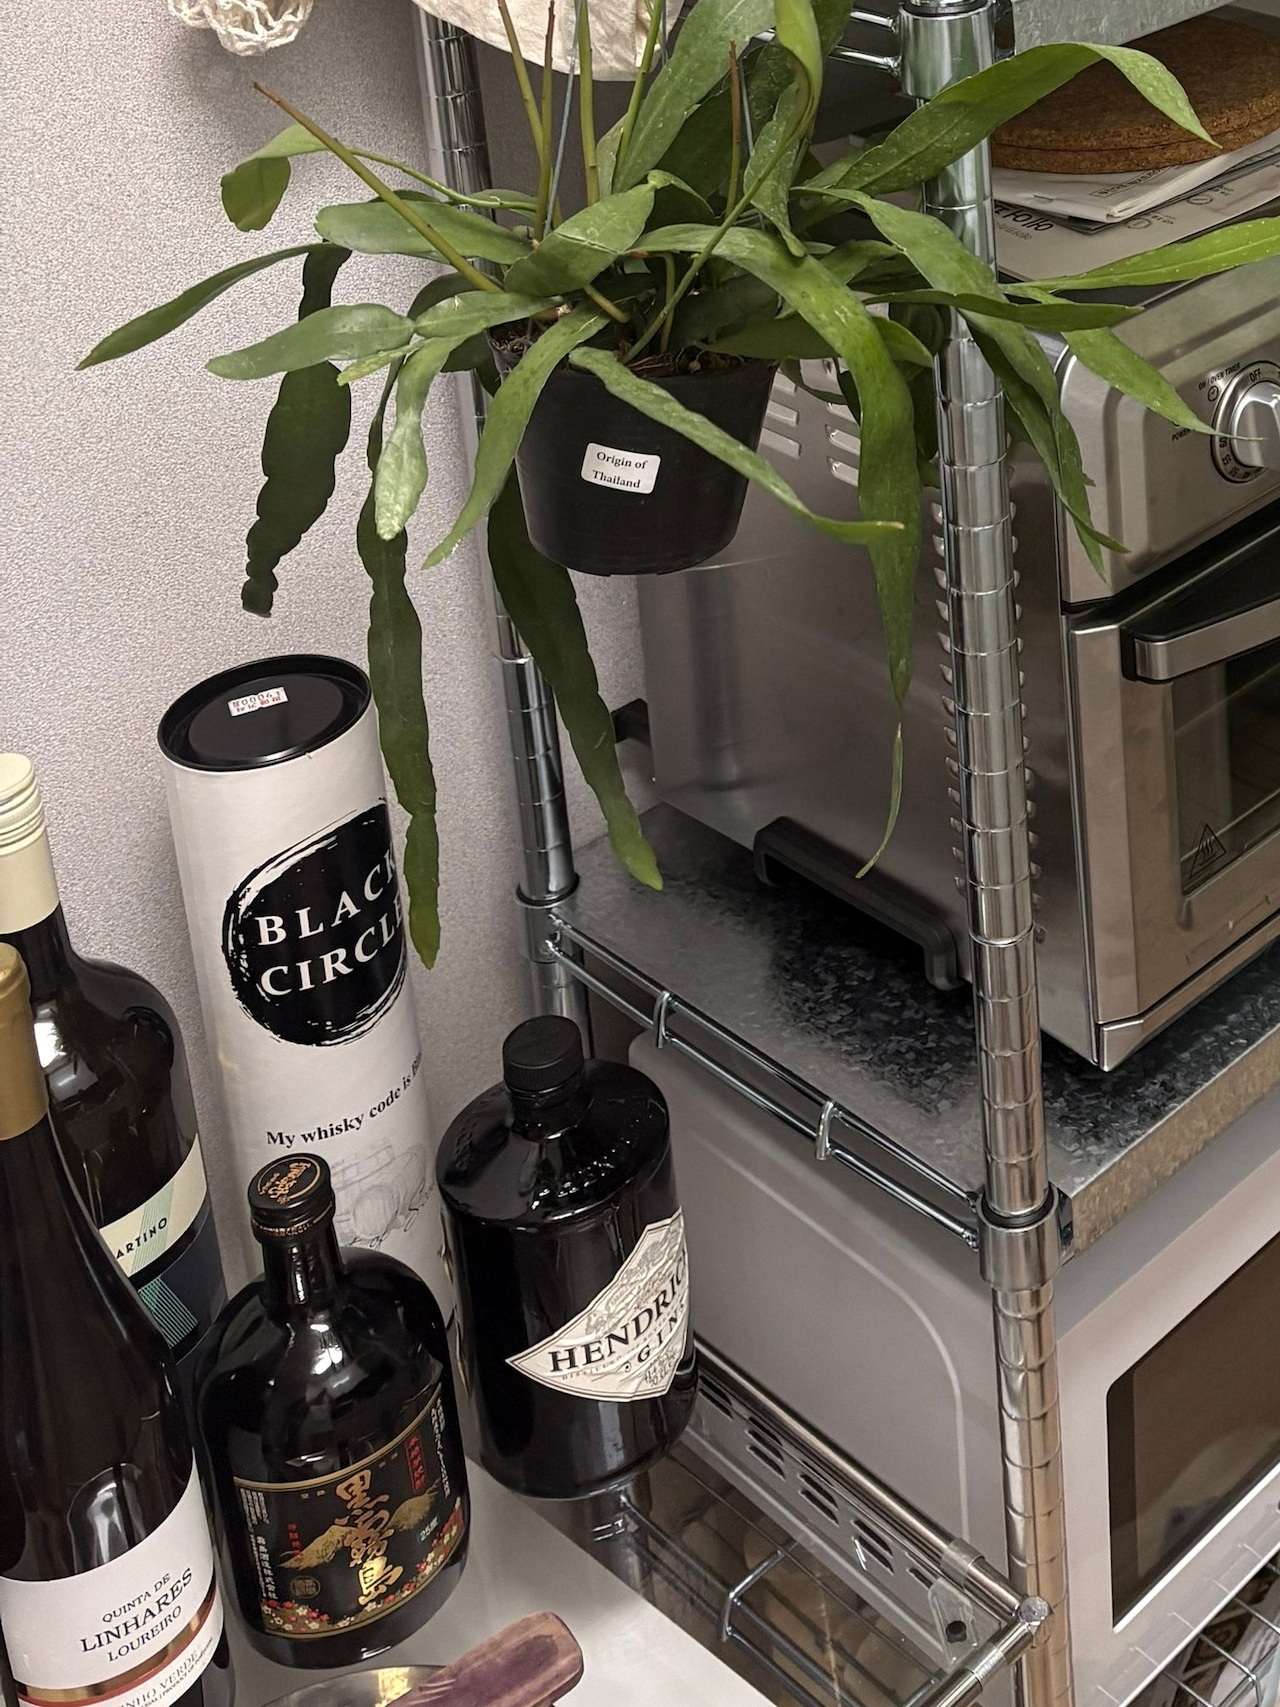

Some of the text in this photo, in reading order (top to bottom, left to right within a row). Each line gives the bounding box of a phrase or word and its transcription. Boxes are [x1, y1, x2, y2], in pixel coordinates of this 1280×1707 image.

[1210, 372, 1224, 385] OVEN
[1224, 362, 1241, 378] TIMER
[1249, 368, 1262, 382] OFF
[592, 469, 641, 488] Thailand
[596, 451, 648, 470] Origin of
[254, 849, 396, 946] BLACK
[260, 894, 404, 996] CIRCLE
[266, 1076, 411, 1149] My whisky code is
[116, 1217, 167, 1259] ARTINO
[548, 1249, 686, 1373] HENDRIC
[79, 1567, 193, 1652] LINHARES
[102, 1572, 171, 1623] QUINTA DE
[108, 1605, 182, 1662] LOUREIRO
